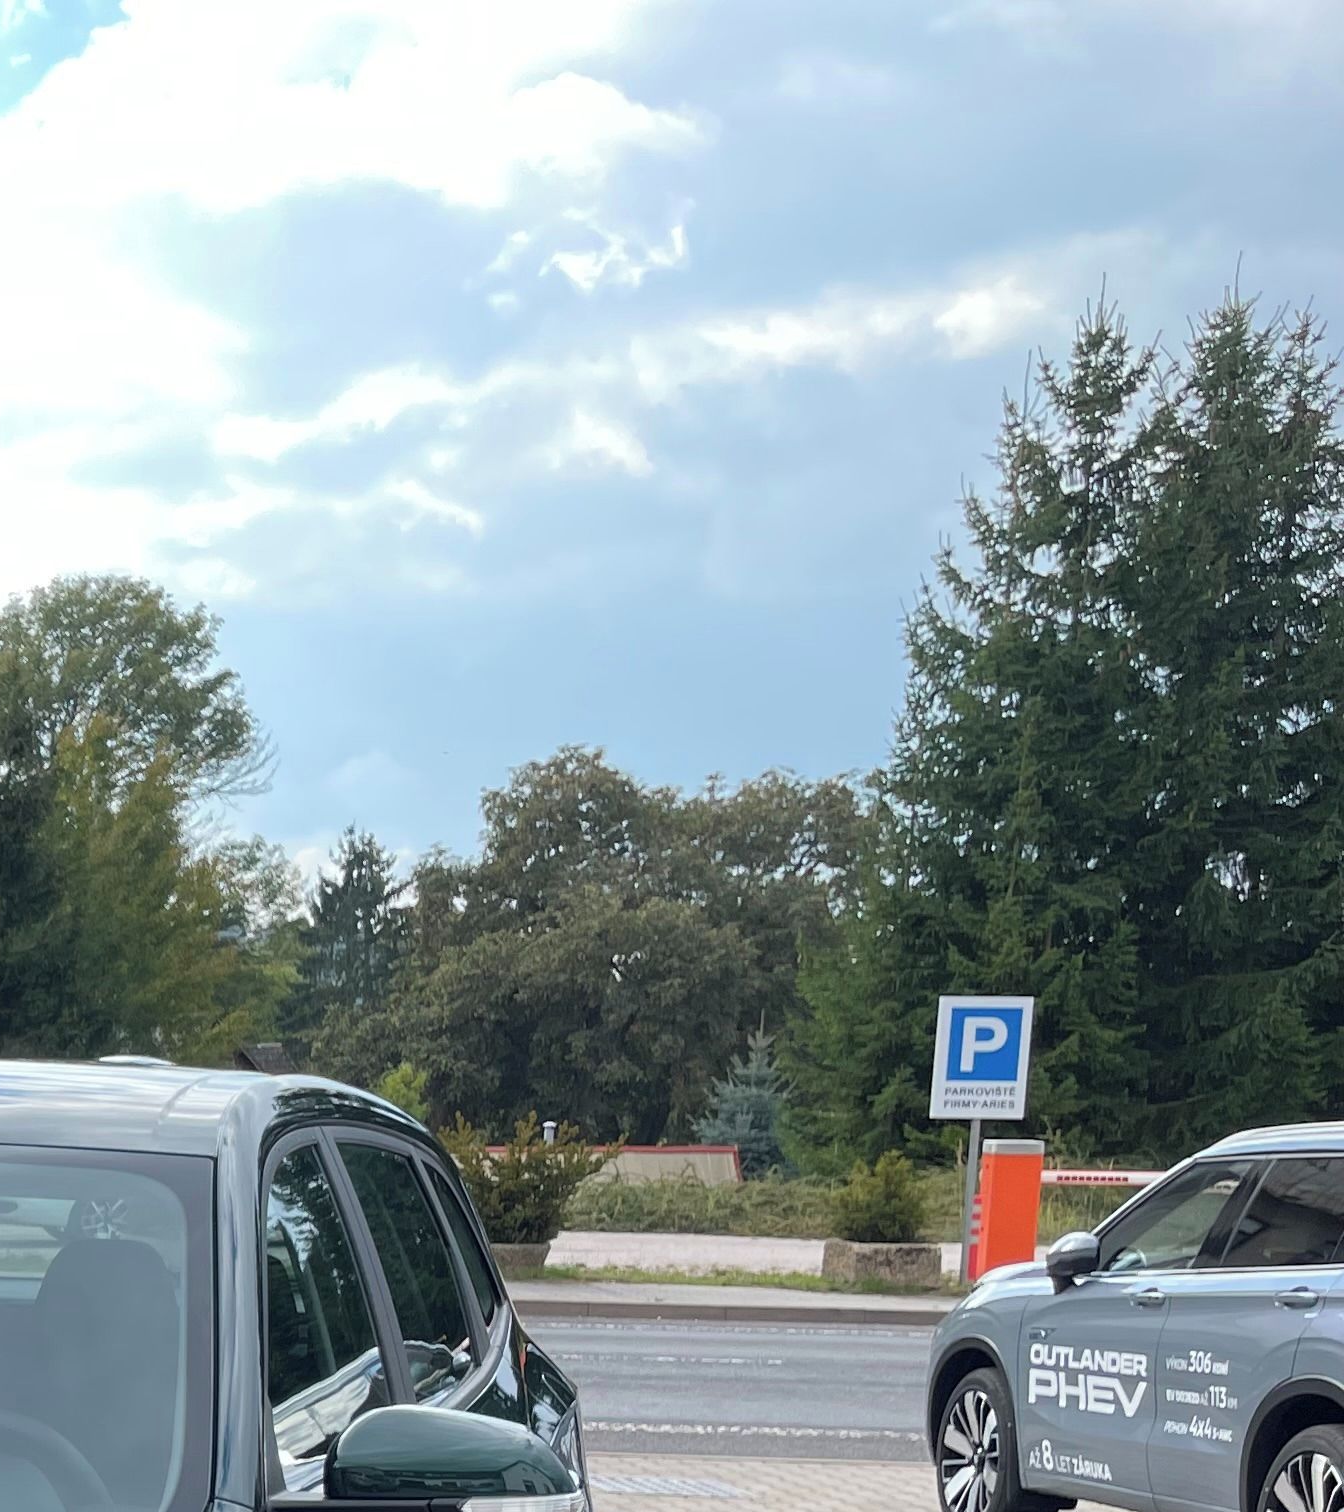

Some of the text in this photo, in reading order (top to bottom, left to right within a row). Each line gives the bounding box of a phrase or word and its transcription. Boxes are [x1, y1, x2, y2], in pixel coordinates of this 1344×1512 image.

[960, 1016, 1008, 1073] P
[1030, 1343, 1147, 1378] OUTLANDER
[1188, 1350, 1212, 1374] 306
[1028, 1368, 1148, 1418] PHEV
[1209, 1385, 1227, 1409] 113
[1041, 1439, 1054, 1471] 8
[1055, 1455, 1071, 1473] LET
[1071, 1452, 1112, 1481] ZÁRUKA
